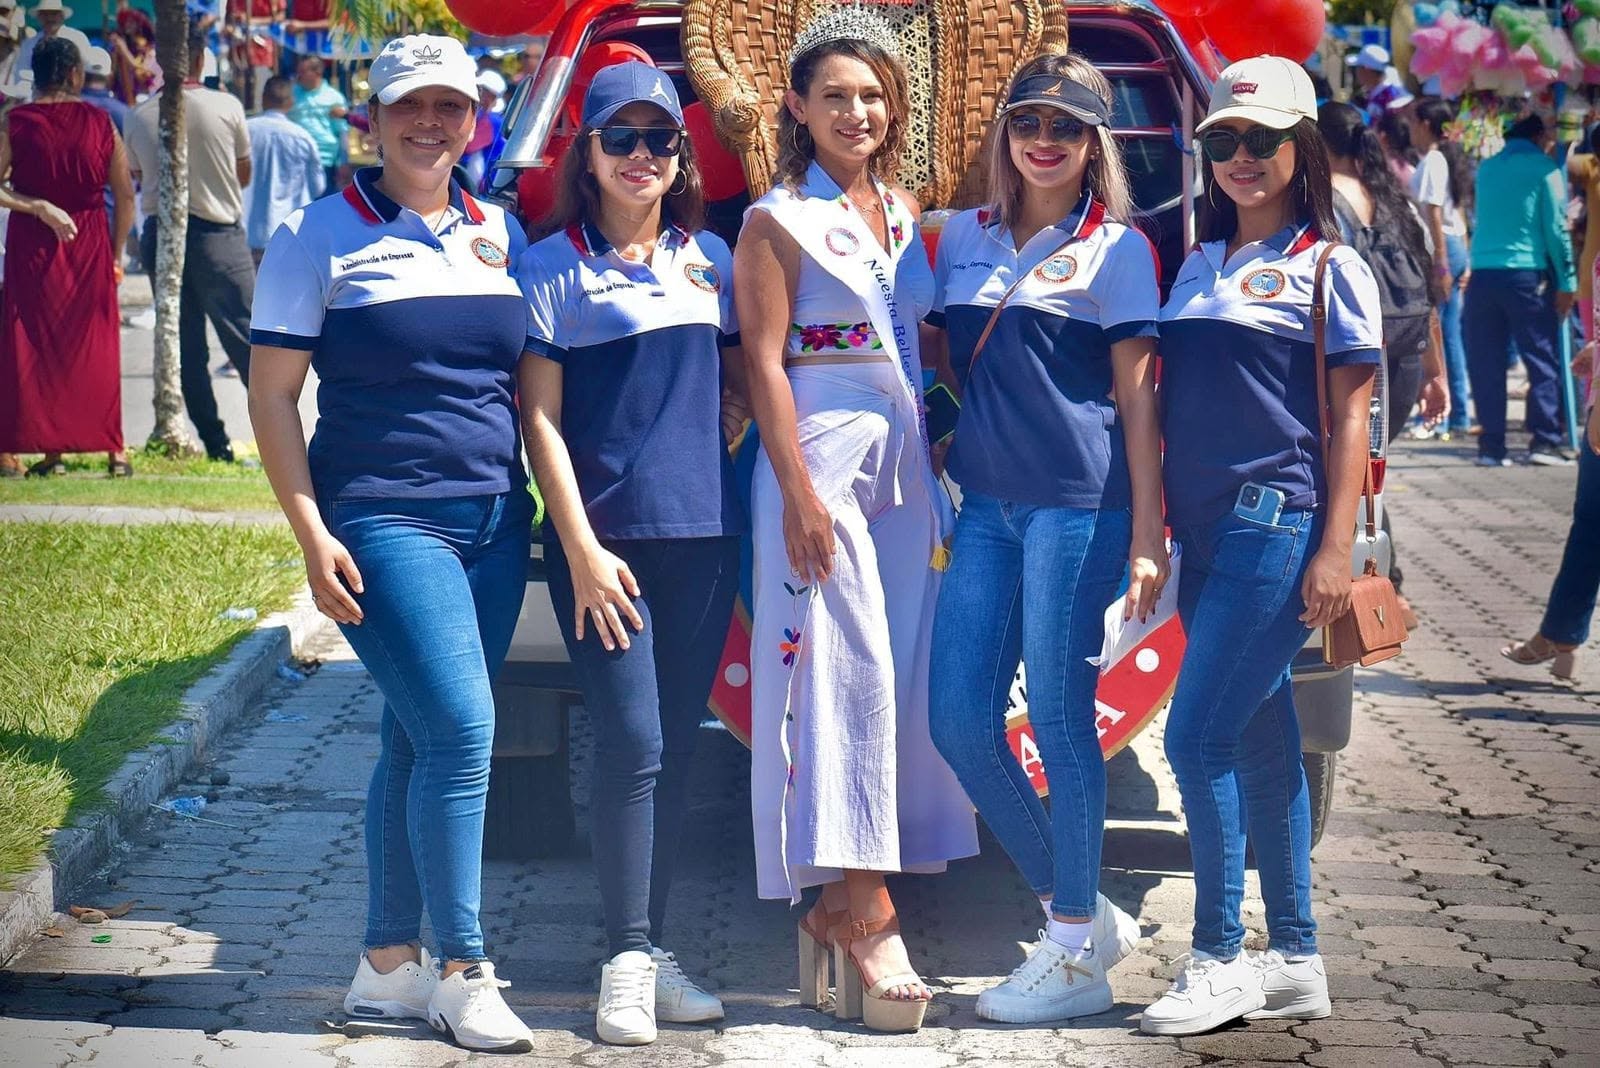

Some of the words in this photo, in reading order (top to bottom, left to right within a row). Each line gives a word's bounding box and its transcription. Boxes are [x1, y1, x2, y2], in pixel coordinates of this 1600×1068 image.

[341, 254, 380, 271] Administración
[381, 253, 389, 262] de
[388, 252, 414, 261] Empresas
